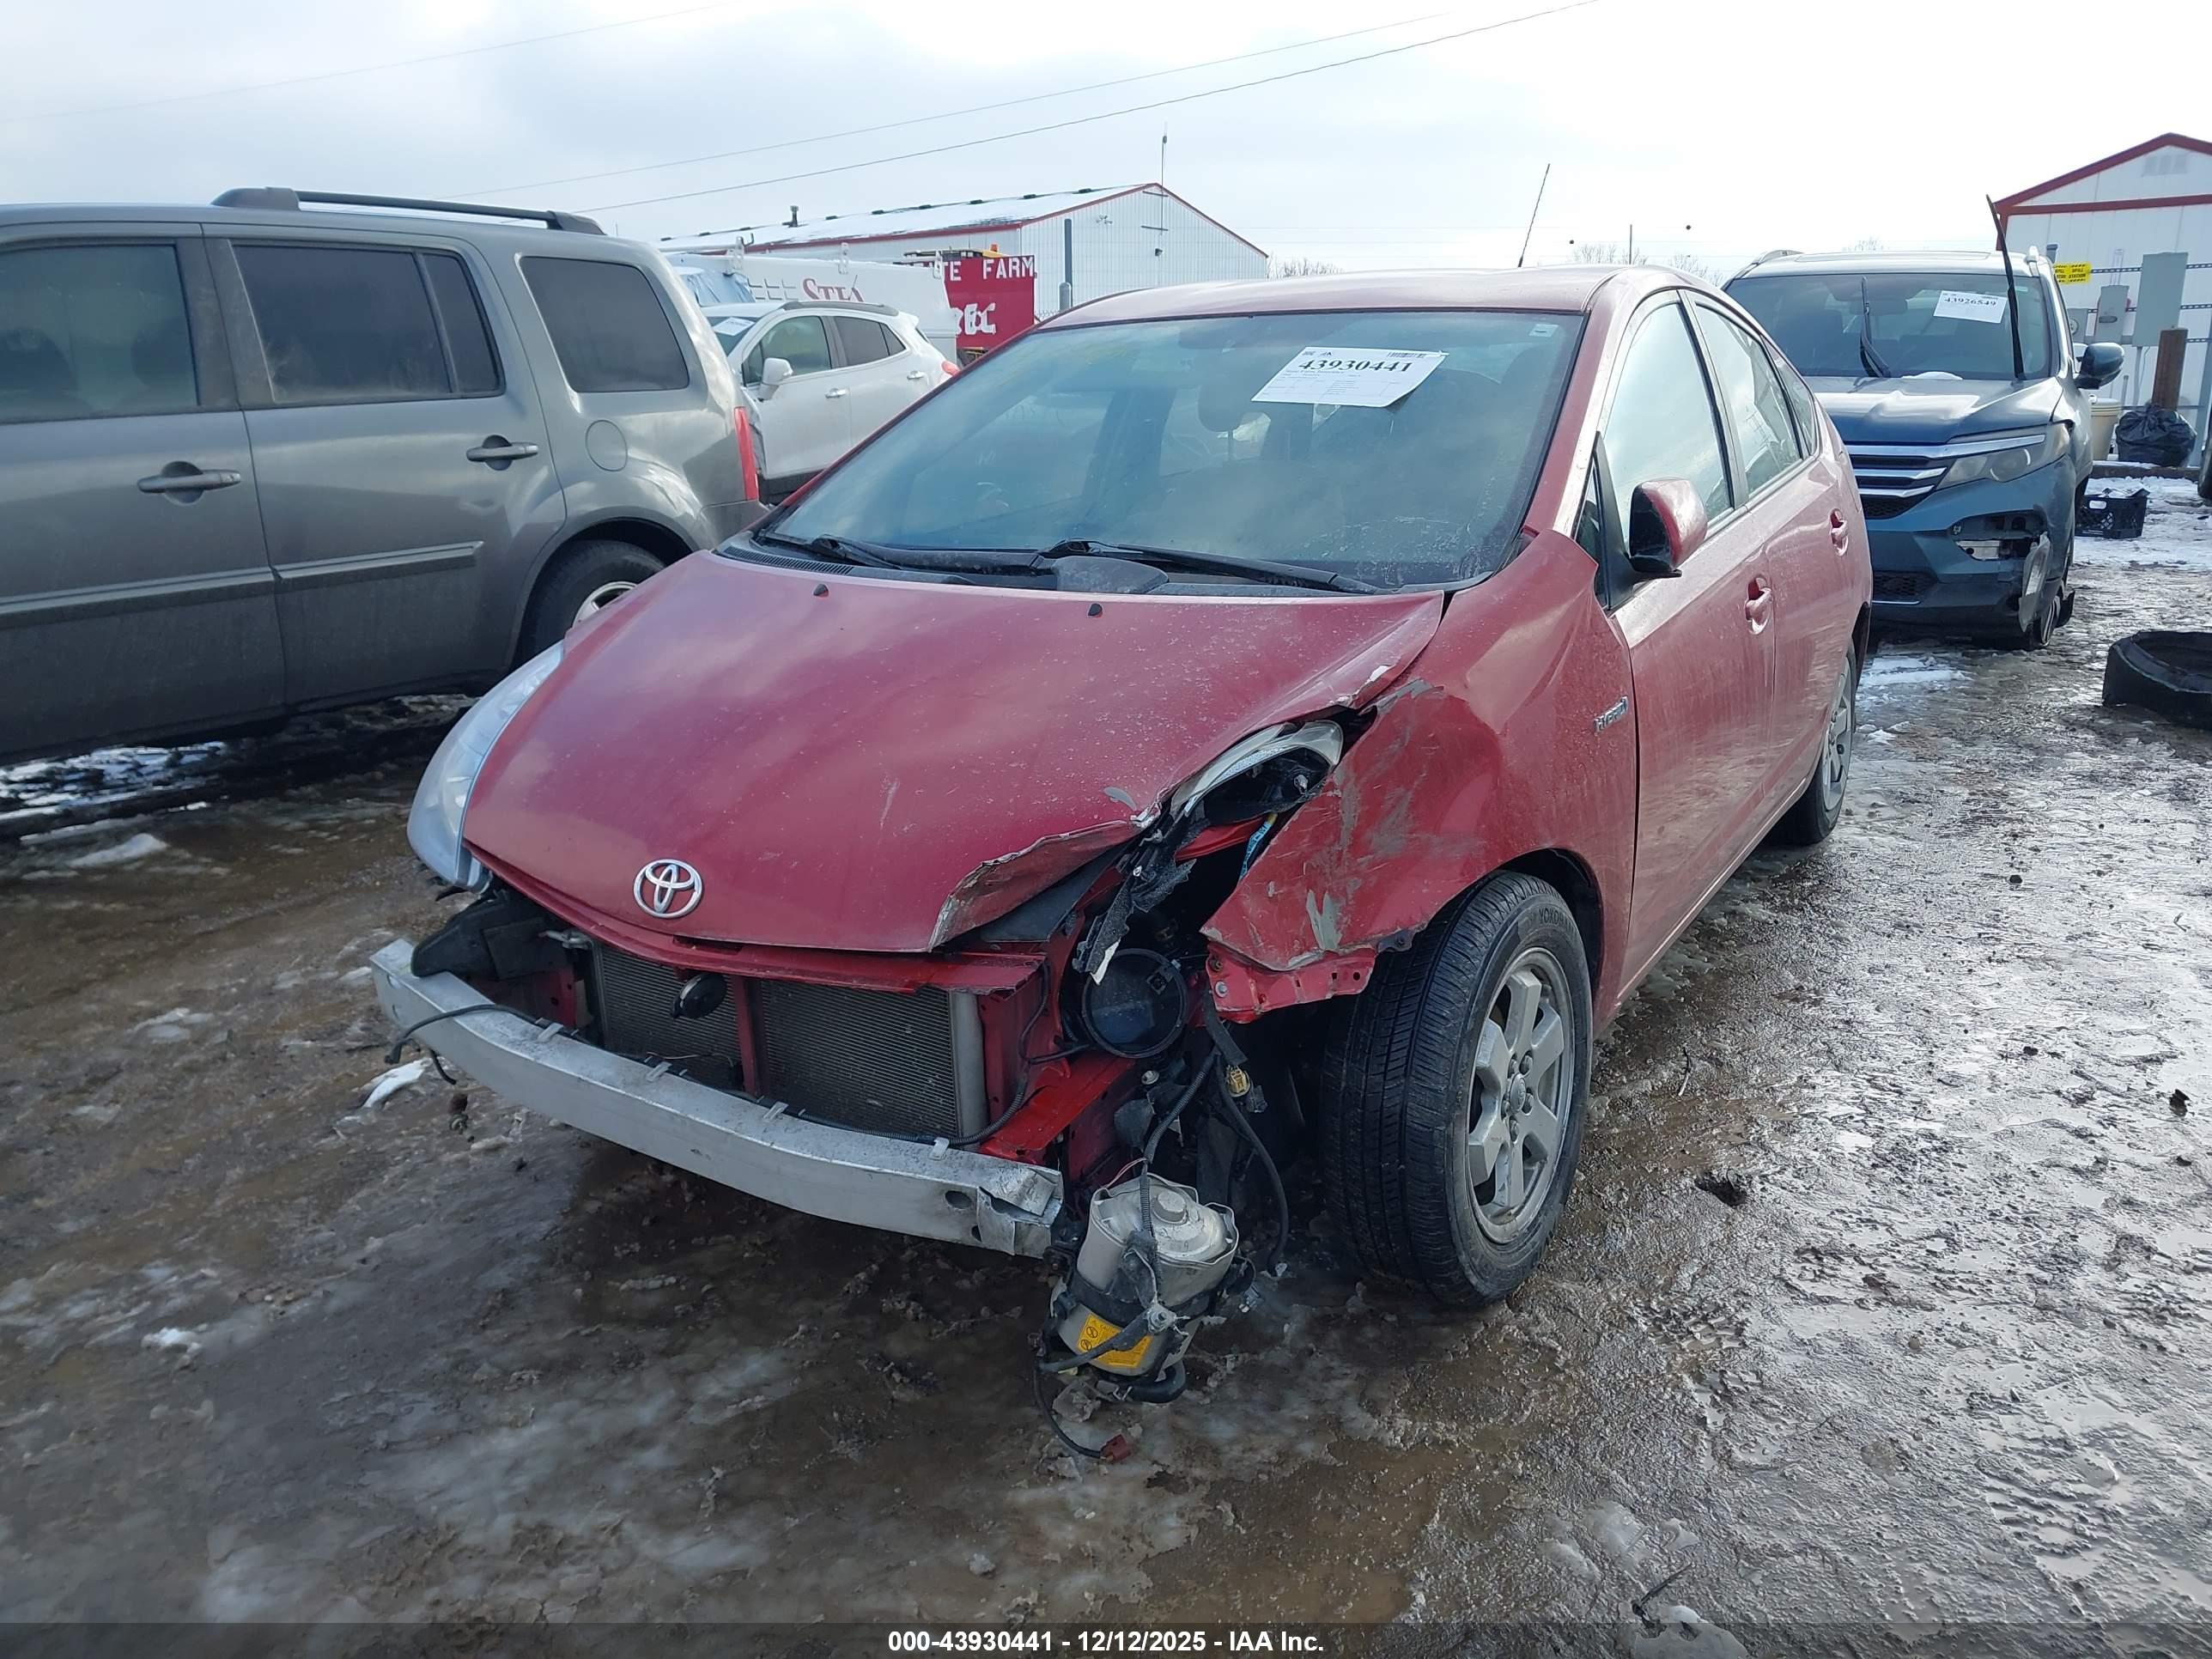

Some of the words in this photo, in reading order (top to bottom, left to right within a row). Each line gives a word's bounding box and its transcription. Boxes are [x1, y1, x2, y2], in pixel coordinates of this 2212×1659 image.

[982, 257, 1034, 280] FARM
[1944, 297, 1997, 306] 43926549
[1298, 359, 1413, 373] 43930441
